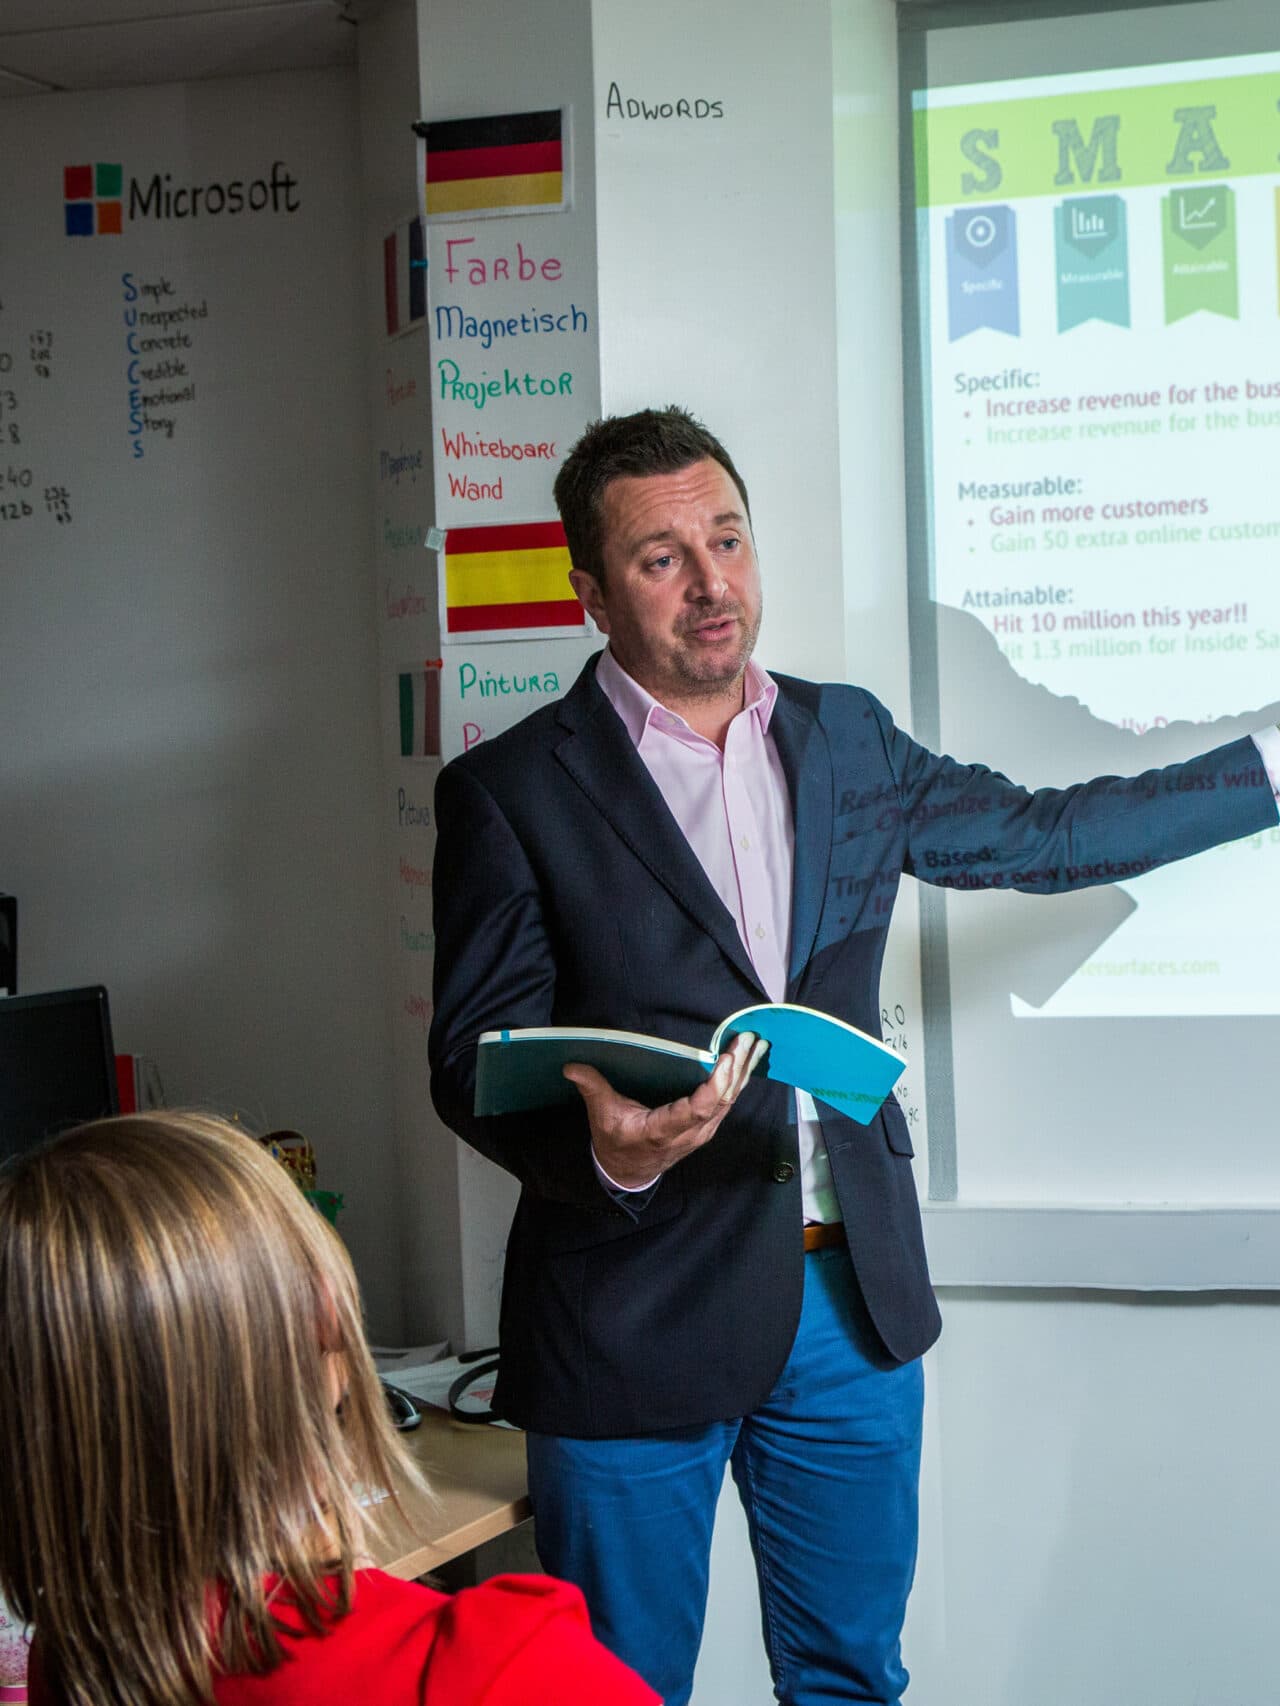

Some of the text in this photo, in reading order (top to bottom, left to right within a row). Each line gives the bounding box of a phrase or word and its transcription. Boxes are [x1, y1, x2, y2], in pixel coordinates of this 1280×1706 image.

[128, 160, 300, 221] Microsoft
[435, 304, 588, 349] Magnetisch
[954, 368, 1041, 395] Specific:
[985, 393, 1072, 418] Increase
[1078, 389, 1161, 411] revenue
[1168, 384, 1197, 406] for
[1205, 380, 1239, 403] the
[985, 420, 1073, 446] Increase
[1079, 416, 1162, 439] revenue
[1168, 411, 1198, 433] for
[1205, 408, 1240, 430] the
[448, 472, 503, 501] Wand
[957, 475, 1083, 501] Measurable:
[989, 494, 1209, 526] Gain more customers
[990, 531, 1036, 554] Gain
[1043, 528, 1069, 551] 50
[1075, 526, 1129, 549] extra
[1135, 521, 1202, 546] online
[962, 584, 1074, 609] Attainable:
[993, 602, 1248, 633] Hit 10 million this year!!
[1032, 639, 1061, 661] 1.3
[1068, 634, 1141, 660] million
[1148, 632, 1177, 655] for
[1184, 630, 1249, 654] Inside
[459, 662, 560, 698] Pintura
